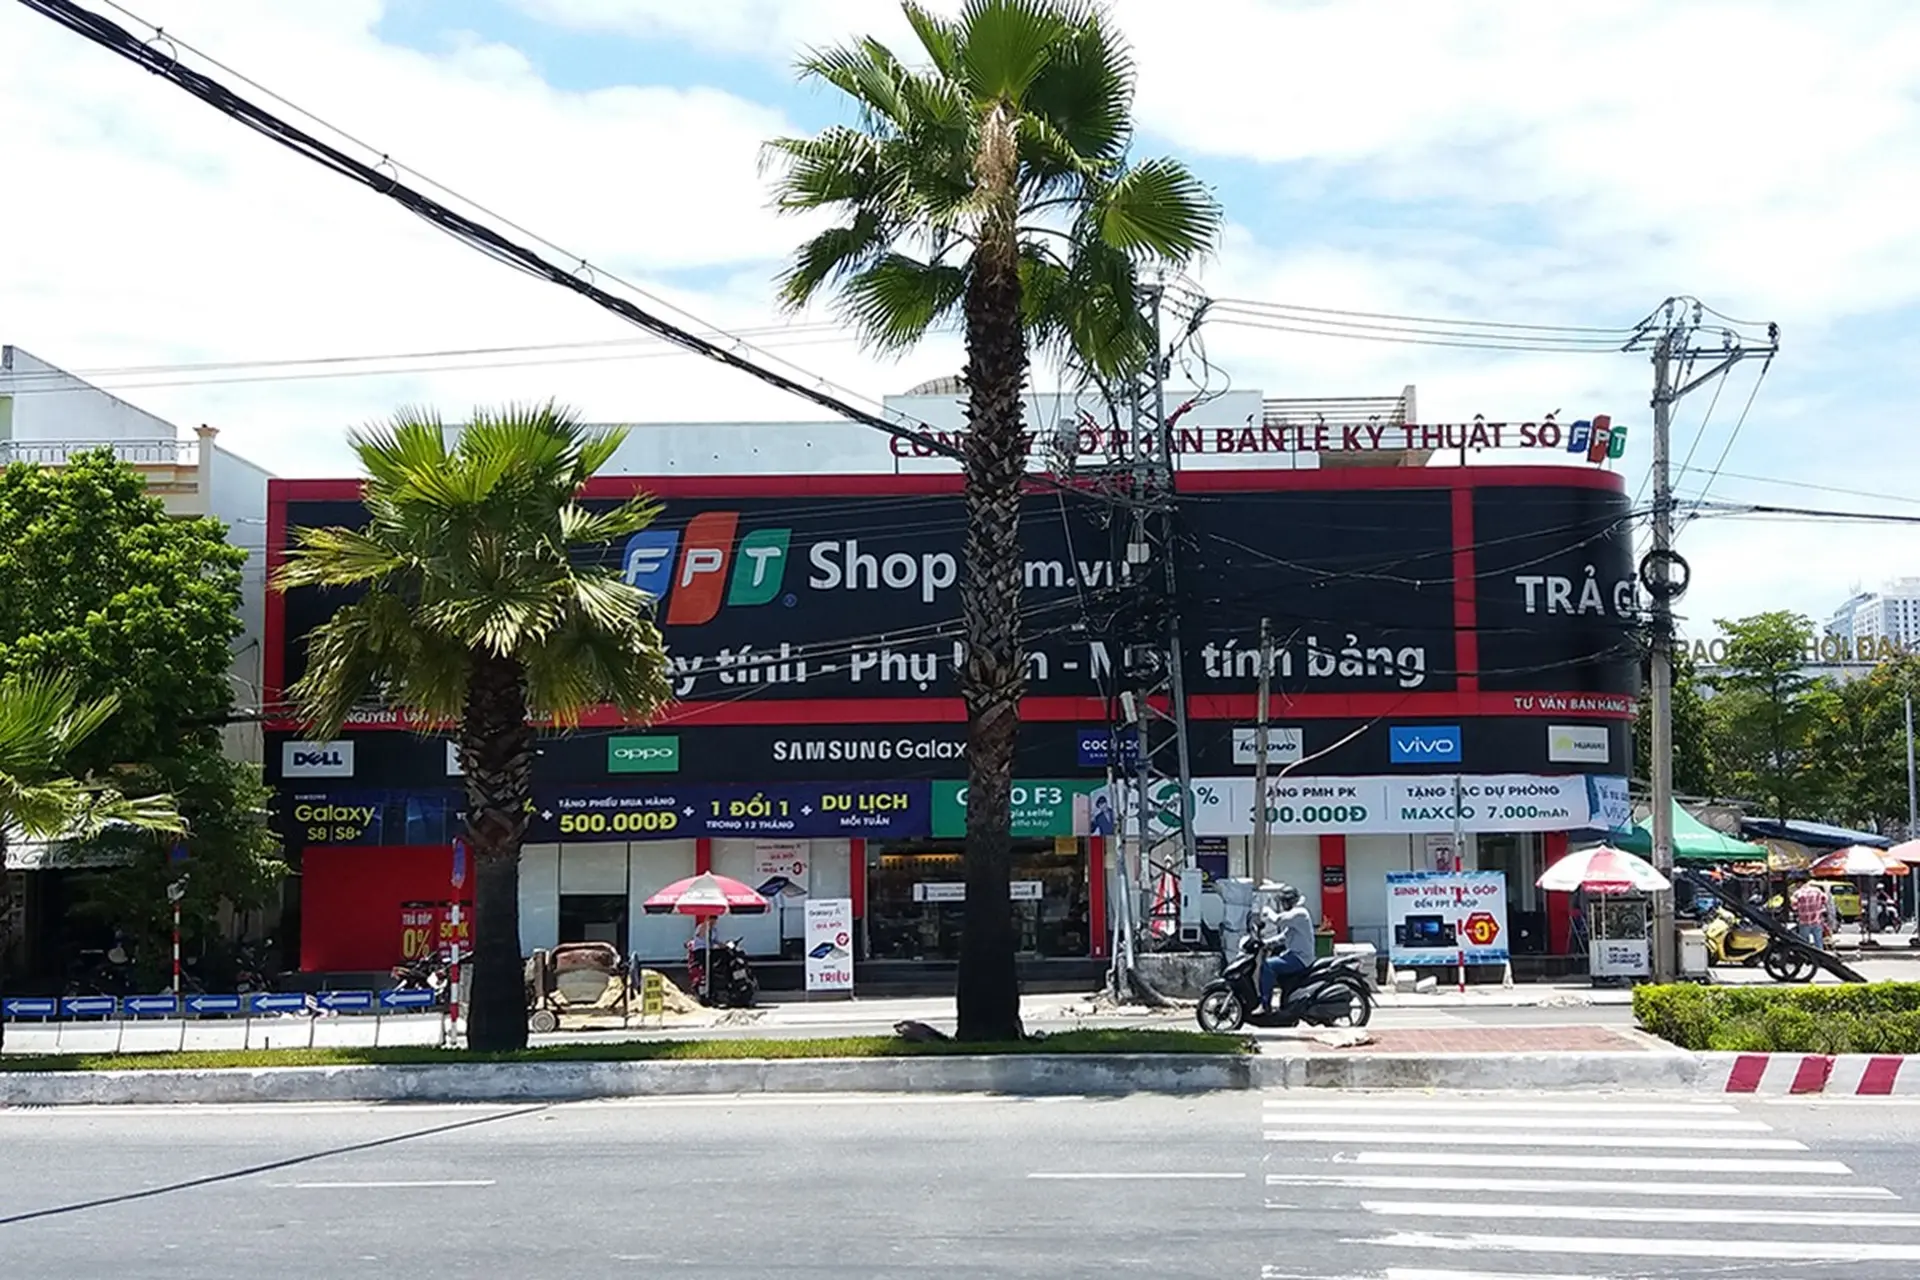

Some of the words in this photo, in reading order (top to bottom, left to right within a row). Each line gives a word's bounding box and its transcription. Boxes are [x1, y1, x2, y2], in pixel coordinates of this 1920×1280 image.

[1216, 414, 1285, 452] BÁN
[1401, 413, 1507, 452] THUẬT
[1519, 408, 1561, 448] SỐ
[1515, 564, 1605, 615] TRẢ
[716, 643, 806, 684] tính
[851, 645, 936, 691] Phụ
[1201, 638, 1291, 678] tính
[1307, 634, 1426, 688] bảng
[614, 747, 673, 760] oppo
[773, 740, 892, 761] SAMSUNG
[896, 739, 967, 759] Galax
[1397, 735, 1454, 754] vivo
[293, 751, 343, 767] DELL
[1034, 788, 1063, 805] F3
[1303, 788, 1334, 798] PMH
[1338, 788, 1357, 798] PK
[1406, 786, 1446, 800] TẶNG
[1484, 785, 1505, 800] DỰ
[1508, 784, 1561, 796] PHÒNG
[711, 801, 720, 816] 1
[729, 792, 771, 817] ĐỔI
[778, 801, 788, 816] 1
[821, 794, 851, 811] DU
[858, 793, 908, 814] LỊCH
[294, 804, 376, 827] Galaxy
[559, 811, 678, 833] 500.000Đ
[706, 820, 741, 830] TRONG
[744, 820, 756, 830] 12
[759, 818, 794, 830] THÁNG
[307, 826, 328, 841] S8
[1394, 887, 1419, 896] SINH
[1422, 884, 1447, 896] VIÊN
[1472, 884, 1498, 895] GÓP
[403, 928, 430, 958] 0%
